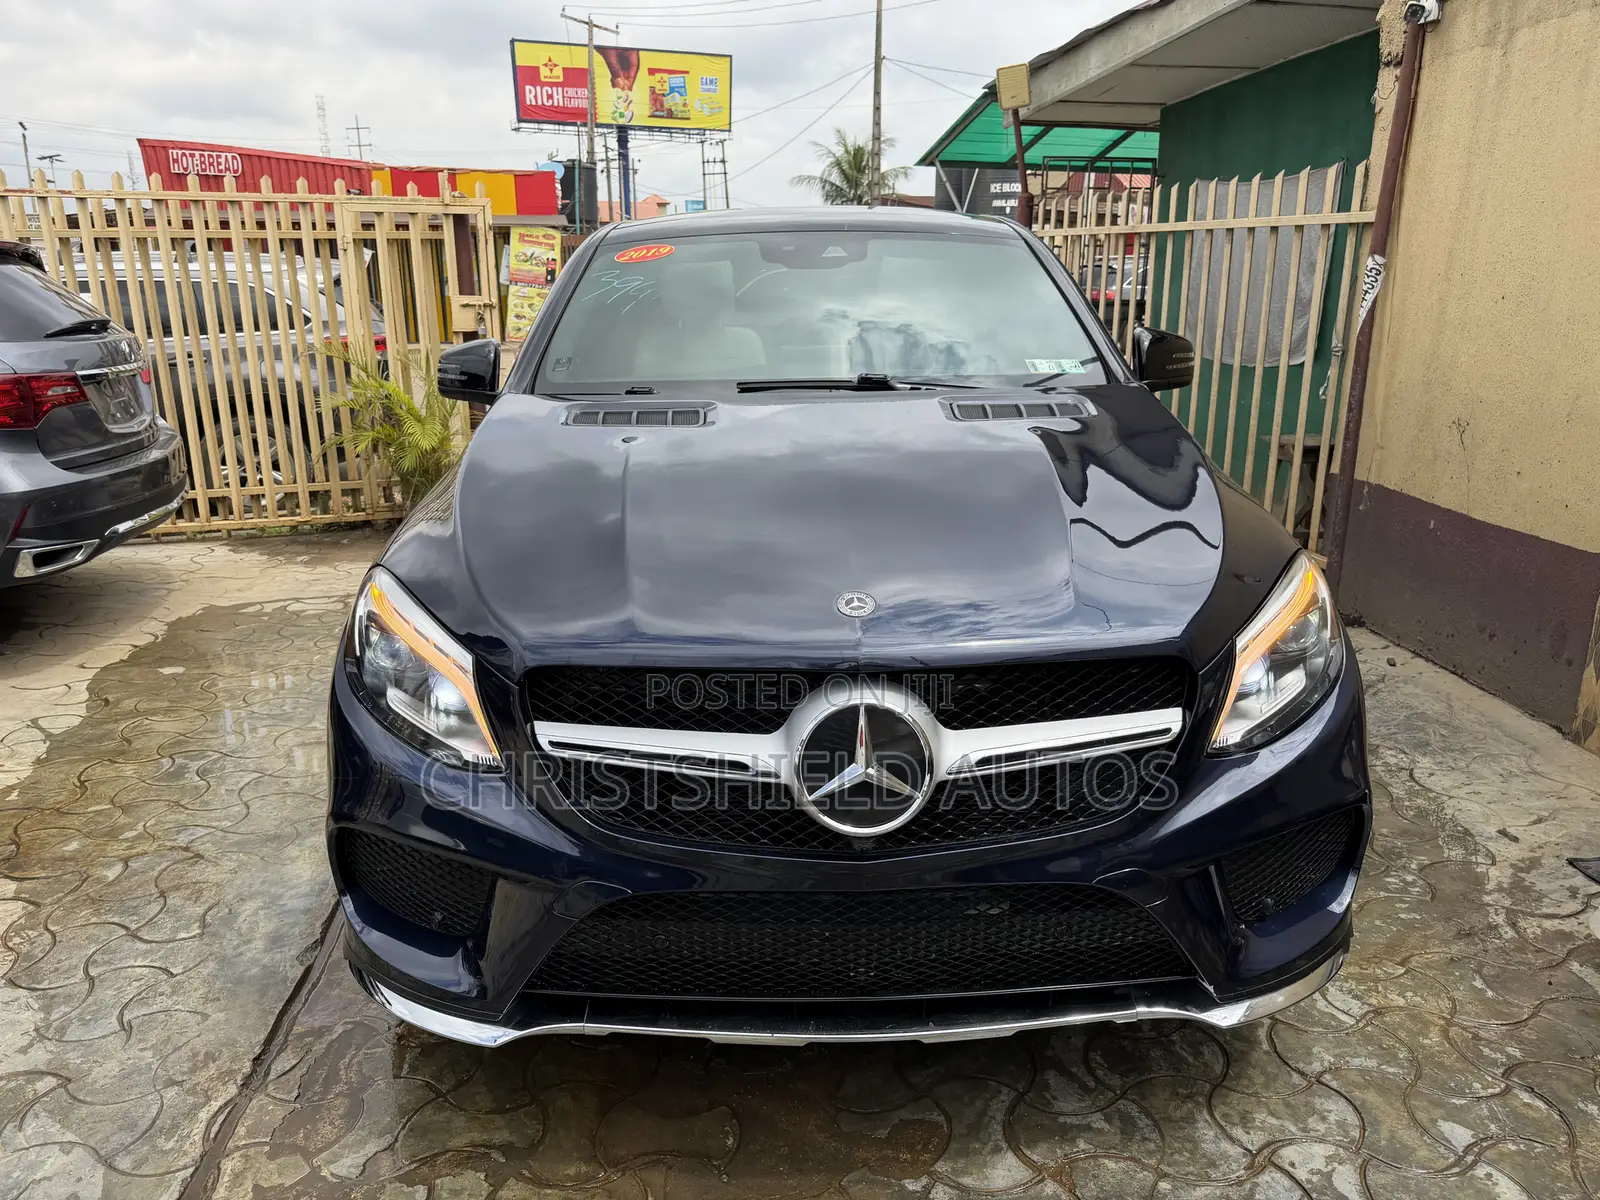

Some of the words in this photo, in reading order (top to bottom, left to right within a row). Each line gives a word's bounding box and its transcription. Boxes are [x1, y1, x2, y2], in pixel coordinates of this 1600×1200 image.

[525, 85, 564, 107] RICH
[564, 97, 588, 108] FLAVOU
[170, 150, 196, 173] HOT
[198, 152, 241, 175] BREAD
[990, 183, 1001, 193] ICE
[620, 246, 671, 261] 2019
